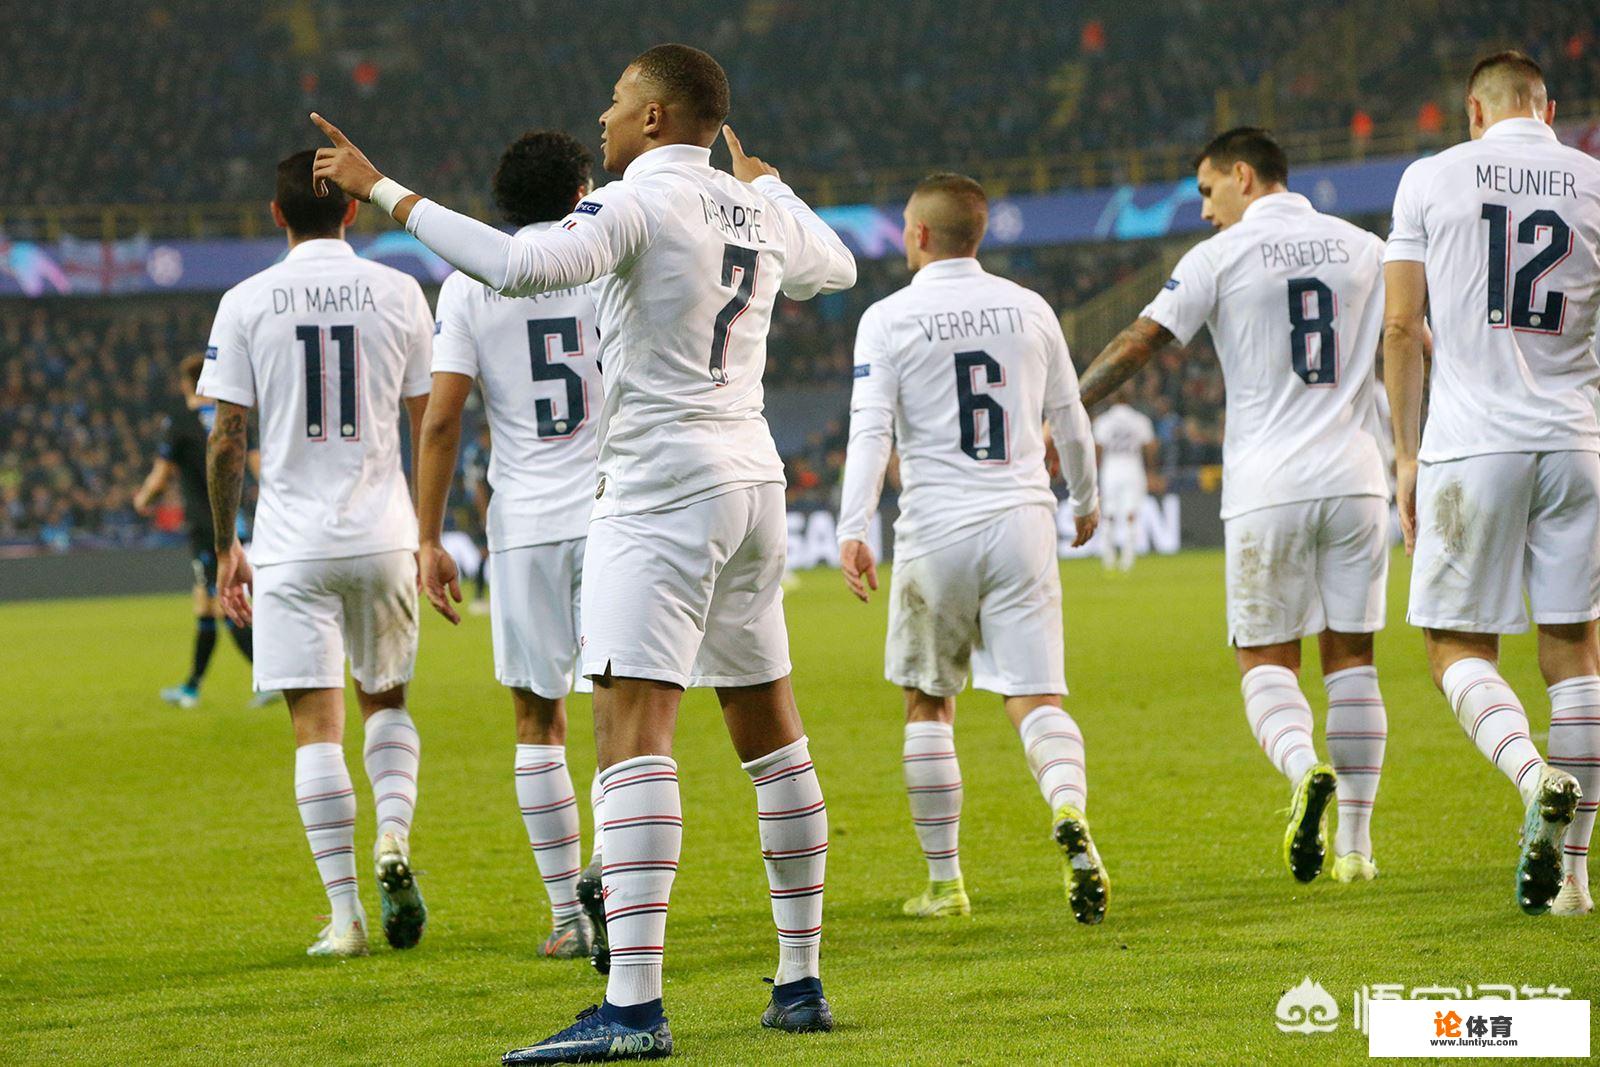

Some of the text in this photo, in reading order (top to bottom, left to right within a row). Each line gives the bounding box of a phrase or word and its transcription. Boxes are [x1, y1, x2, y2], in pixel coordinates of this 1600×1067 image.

[1476, 165, 1577, 198] MEUNIER
[272, 280, 376, 314] DI MARÍA
[1261, 238, 1350, 268] PAREDES
[1481, 203, 1574, 335] 12
[709, 243, 760, 388] 7
[918, 307, 1025, 342] VERRATTI
[1287, 277, 1341, 389] 8
[296, 325, 360, 442] 11
[526, 316, 590, 441] 5
[954, 350, 1011, 465] 6
[607, 1030, 666, 1057] MDS
